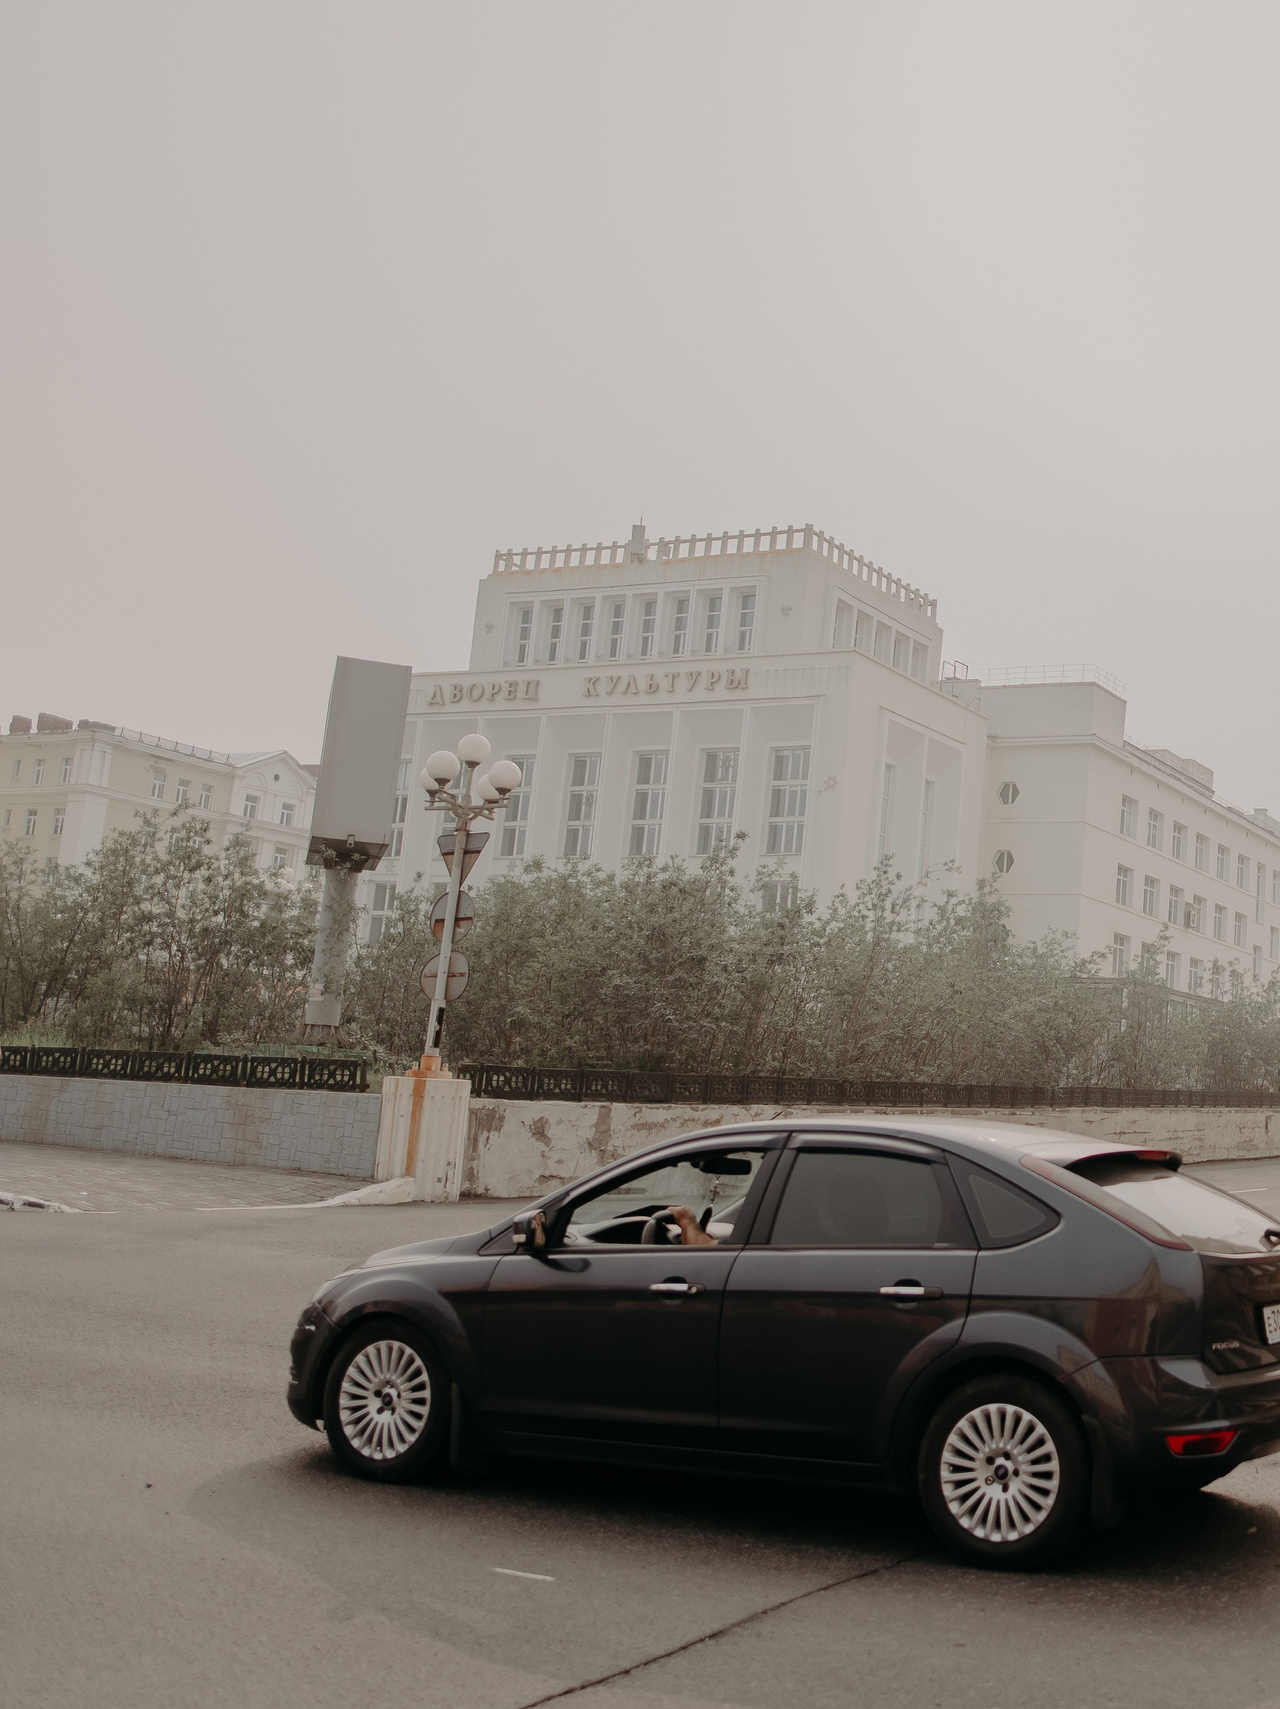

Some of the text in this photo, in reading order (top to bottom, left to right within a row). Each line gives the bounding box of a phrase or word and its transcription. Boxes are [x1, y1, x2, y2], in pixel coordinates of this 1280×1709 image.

[427, 666, 751, 707] ДВОРЕЦ КУЛЬТУРЫ
[1212, 1340, 1240, 1350] FOCUS
